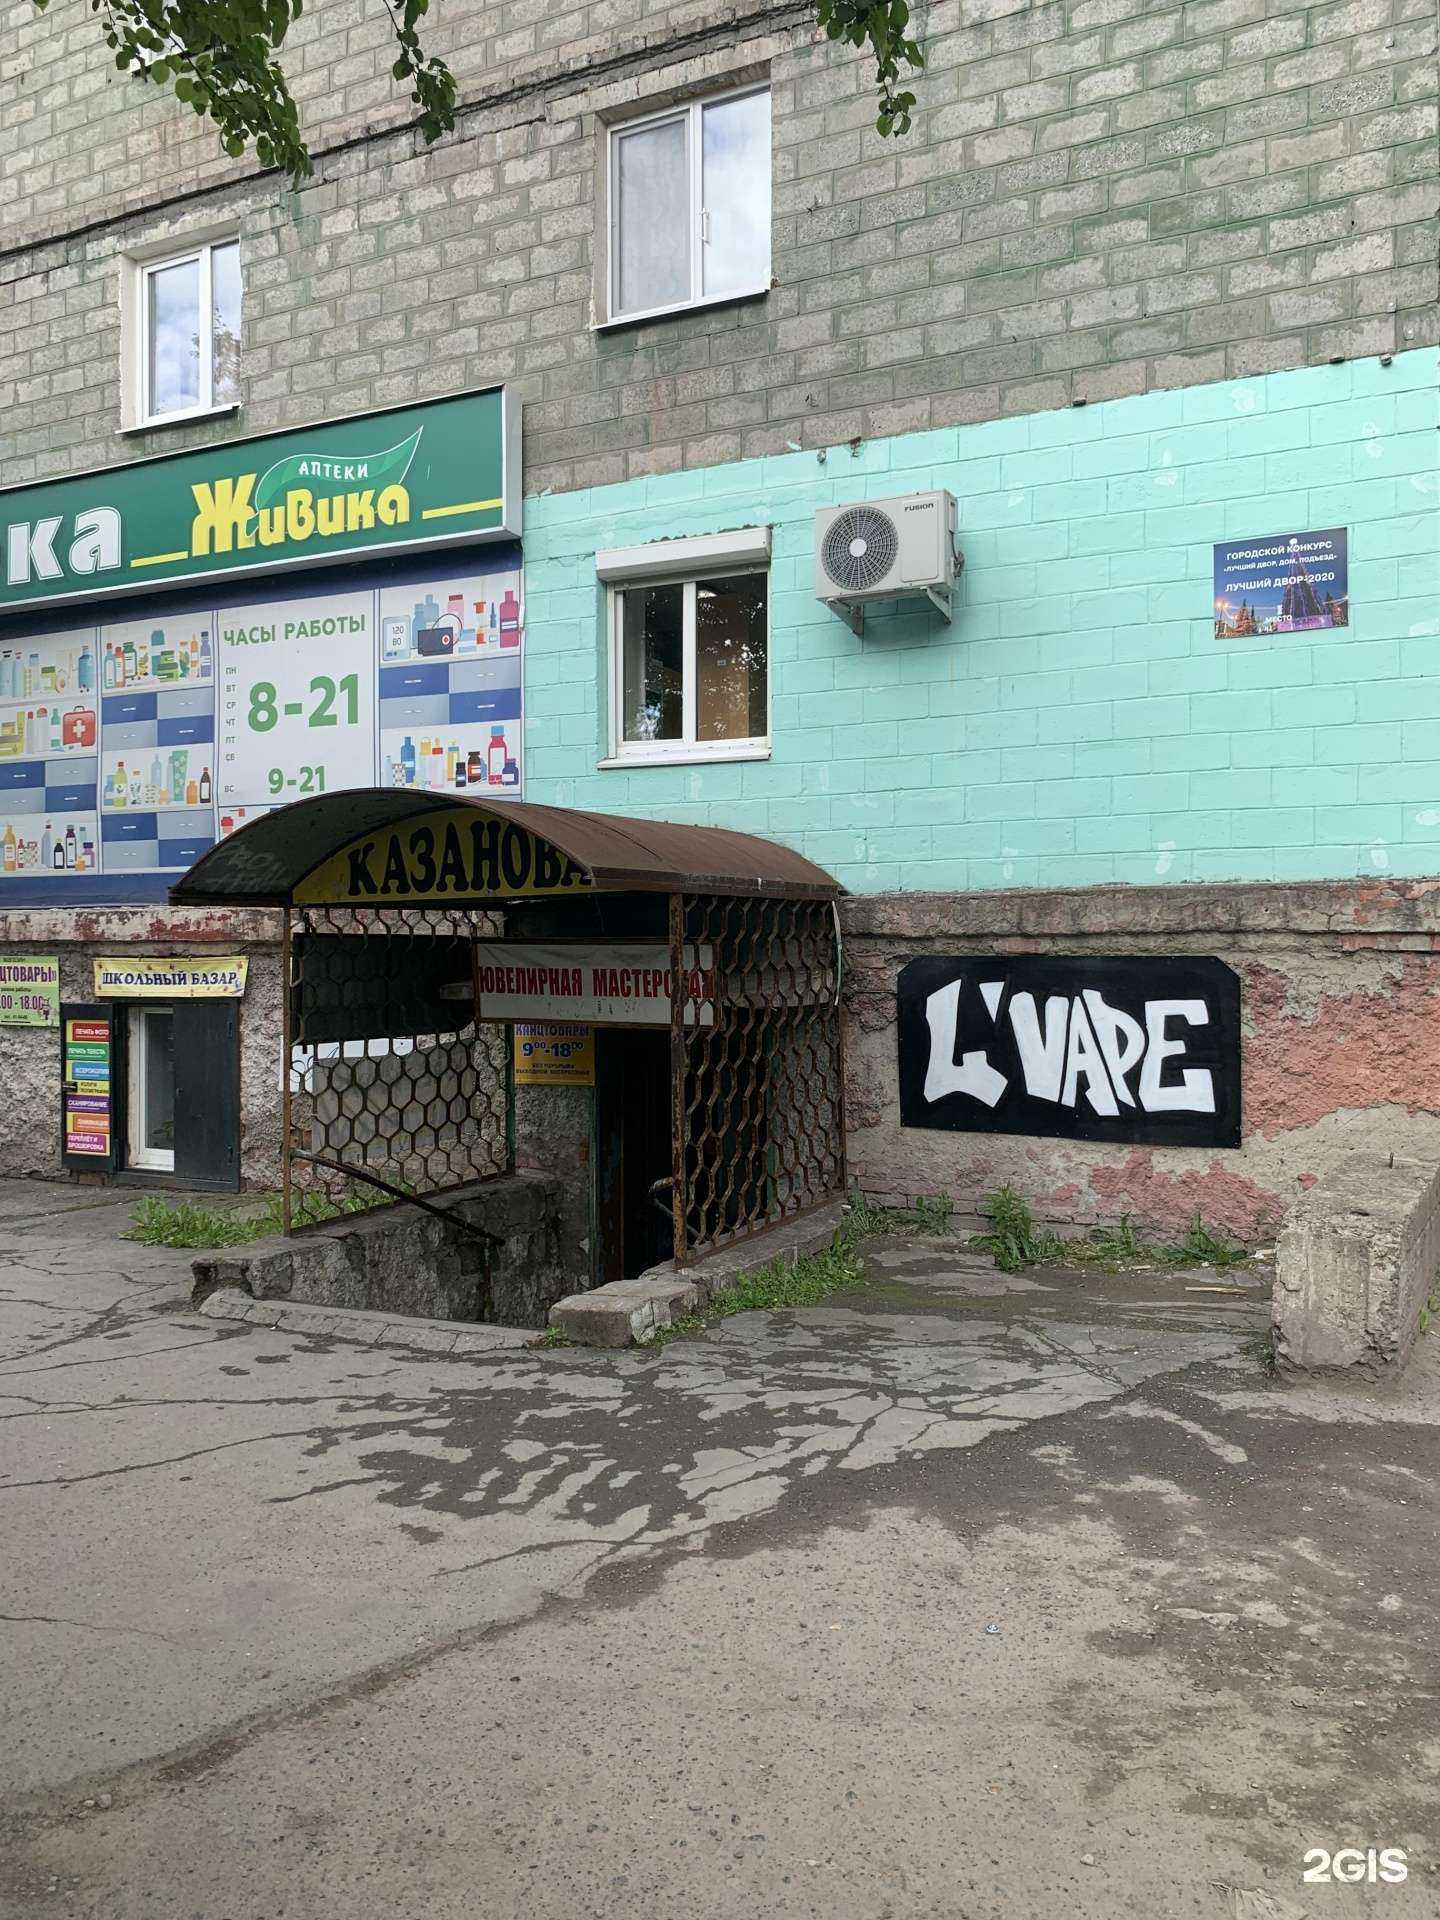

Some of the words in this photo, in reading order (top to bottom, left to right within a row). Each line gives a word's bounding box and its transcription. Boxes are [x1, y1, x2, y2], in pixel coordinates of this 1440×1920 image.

[299, 461, 369, 481] АПТЕКИ
[191, 473, 410, 558] Живика
[1226, 545, 1285, 561] ГОРОДСКОЙ
[1287, 540, 1333, 553] КОНКУРС
[1225, 577, 1272, 593] ЛУЧШИЙ
[223, 625, 276, 647] ЧАСЫ
[284, 614, 366, 641] РАБОТЫ
[225, 667, 237, 676] ПН
[226, 684, 236, 693] ВТ
[226, 701, 236, 710] СР
[247, 673, 359, 733] 8-21
[225, 718, 236, 727] ЧТ
[225, 736, 236, 744] ПТ
[225, 753, 235, 761] СБ
[224, 785, 235, 793] ВС
[268, 765, 326, 795] 9-21
[102, 969, 188, 987] ШКОЛЬНЫЙ
[191, 971, 237, 985] БАЗАР
[479, 966, 583, 997] ЮВЕЛИРНАЯ
[924, 978, 1216, 1117] L'VAPE
